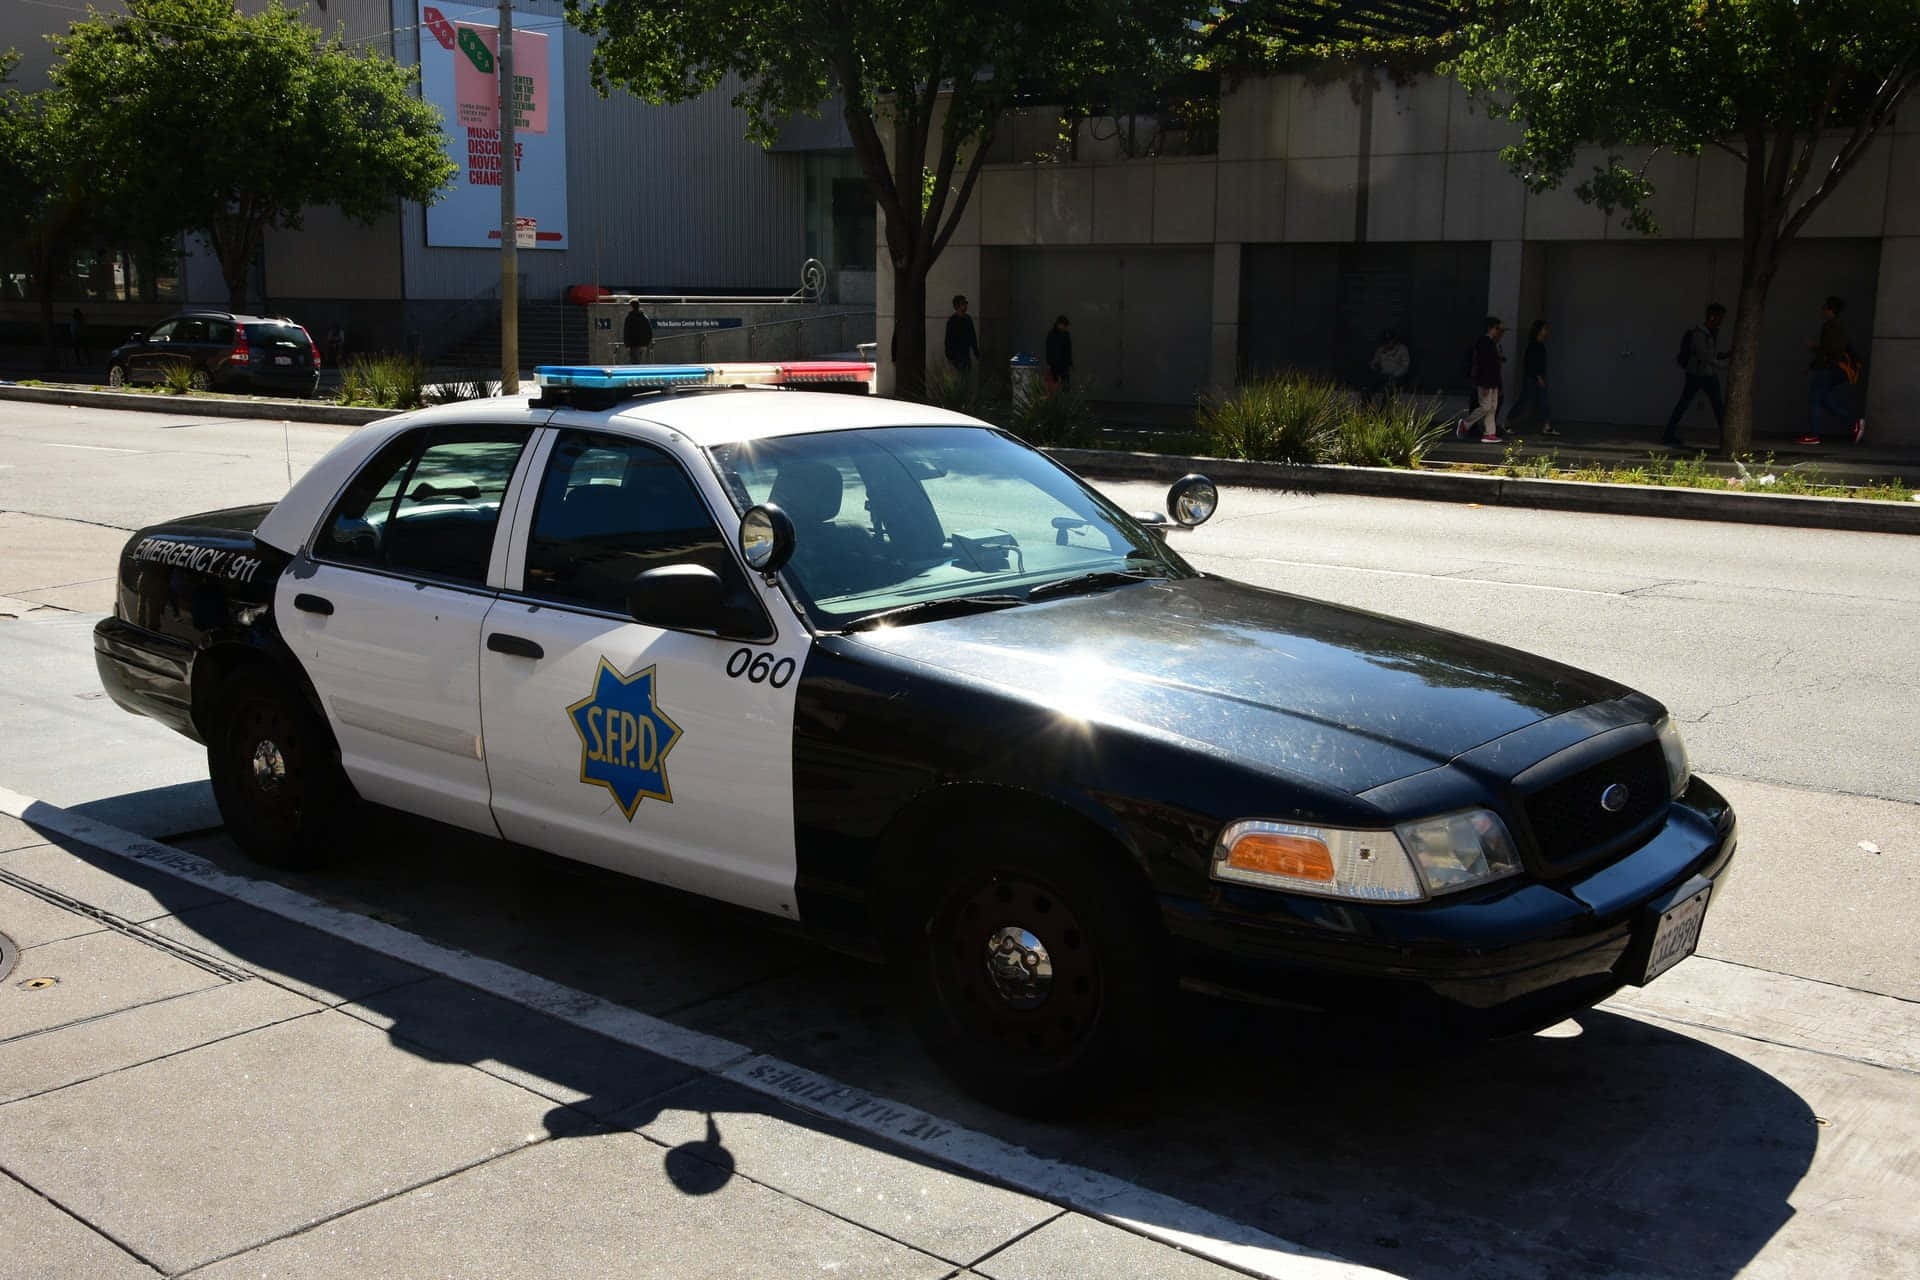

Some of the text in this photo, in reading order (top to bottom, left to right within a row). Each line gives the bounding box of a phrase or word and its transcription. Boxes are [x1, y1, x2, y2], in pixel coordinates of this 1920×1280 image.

[468, 127, 499, 140] MUSIC
[468, 139, 523, 157] DISCOE
[469, 170, 503, 186] CHANG
[130, 538, 262, 583] EMERGENCY 911
[727, 647, 796, 689] 060
